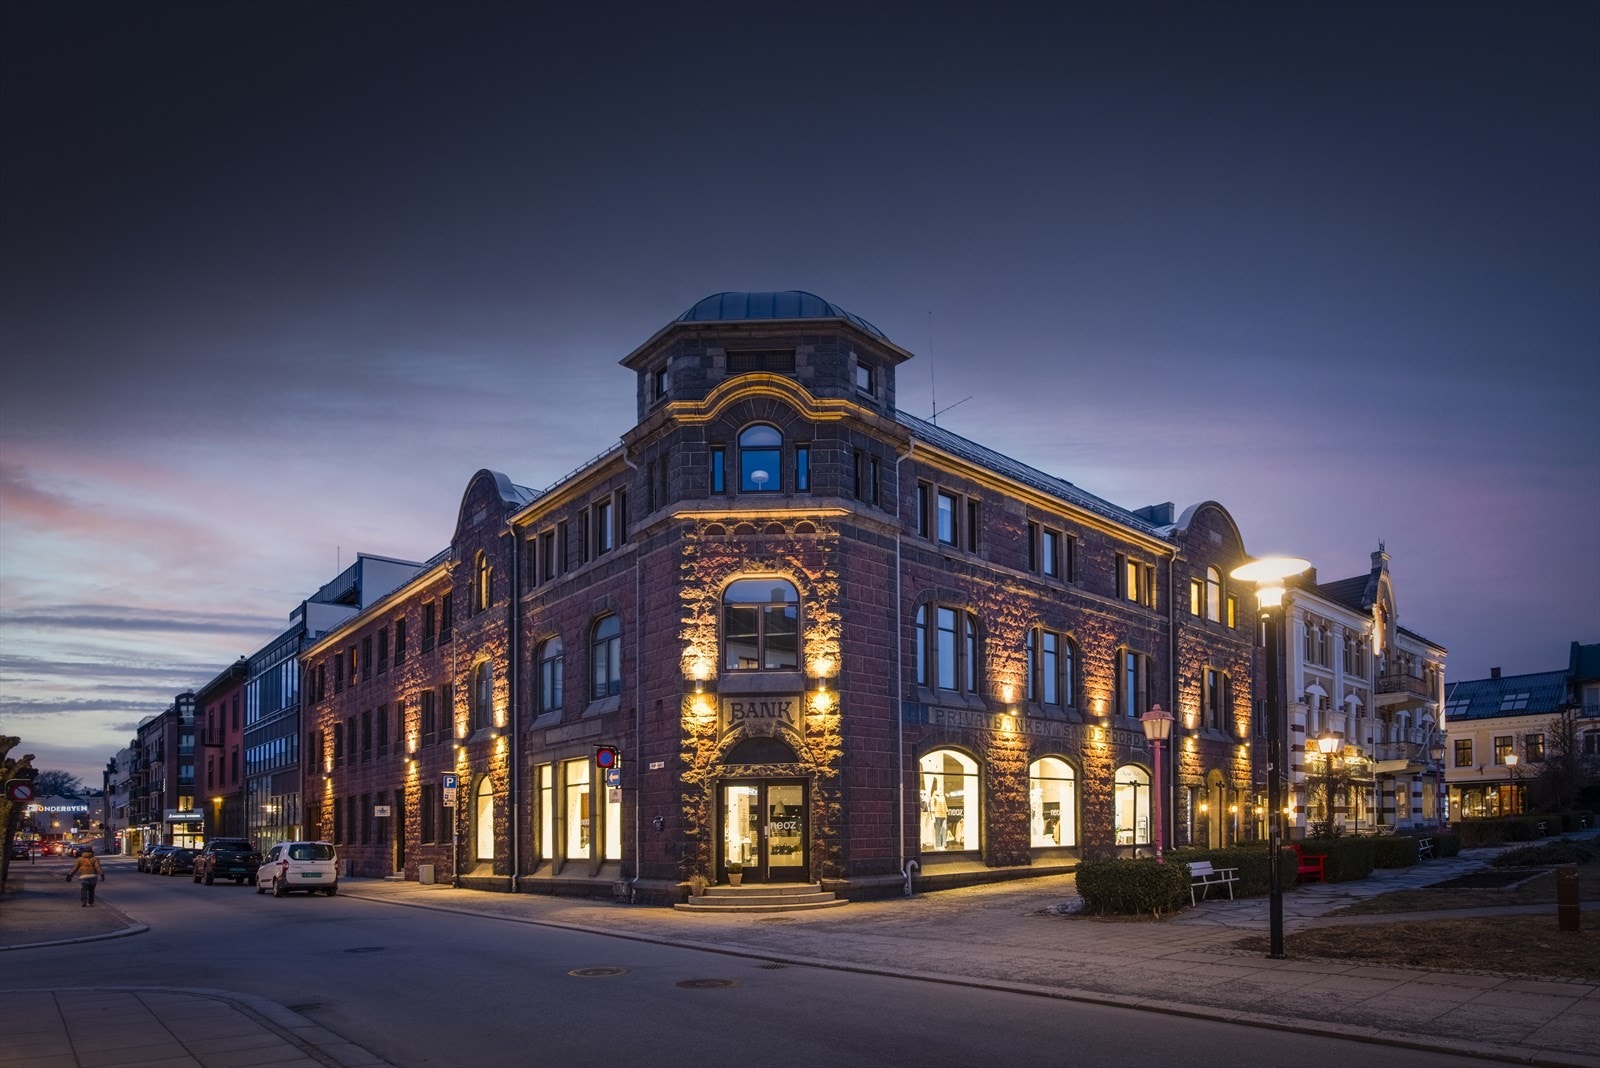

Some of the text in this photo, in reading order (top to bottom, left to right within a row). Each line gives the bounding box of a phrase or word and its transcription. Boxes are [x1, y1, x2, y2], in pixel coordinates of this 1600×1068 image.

[728, 702, 795, 726] BANK
[935, 709, 1051, 735] PRIVATBANKEN
[1063, 725, 1140, 744] SANDEFJORD
[446, 777, 455, 787] P
[770, 821, 796, 830] neoz
